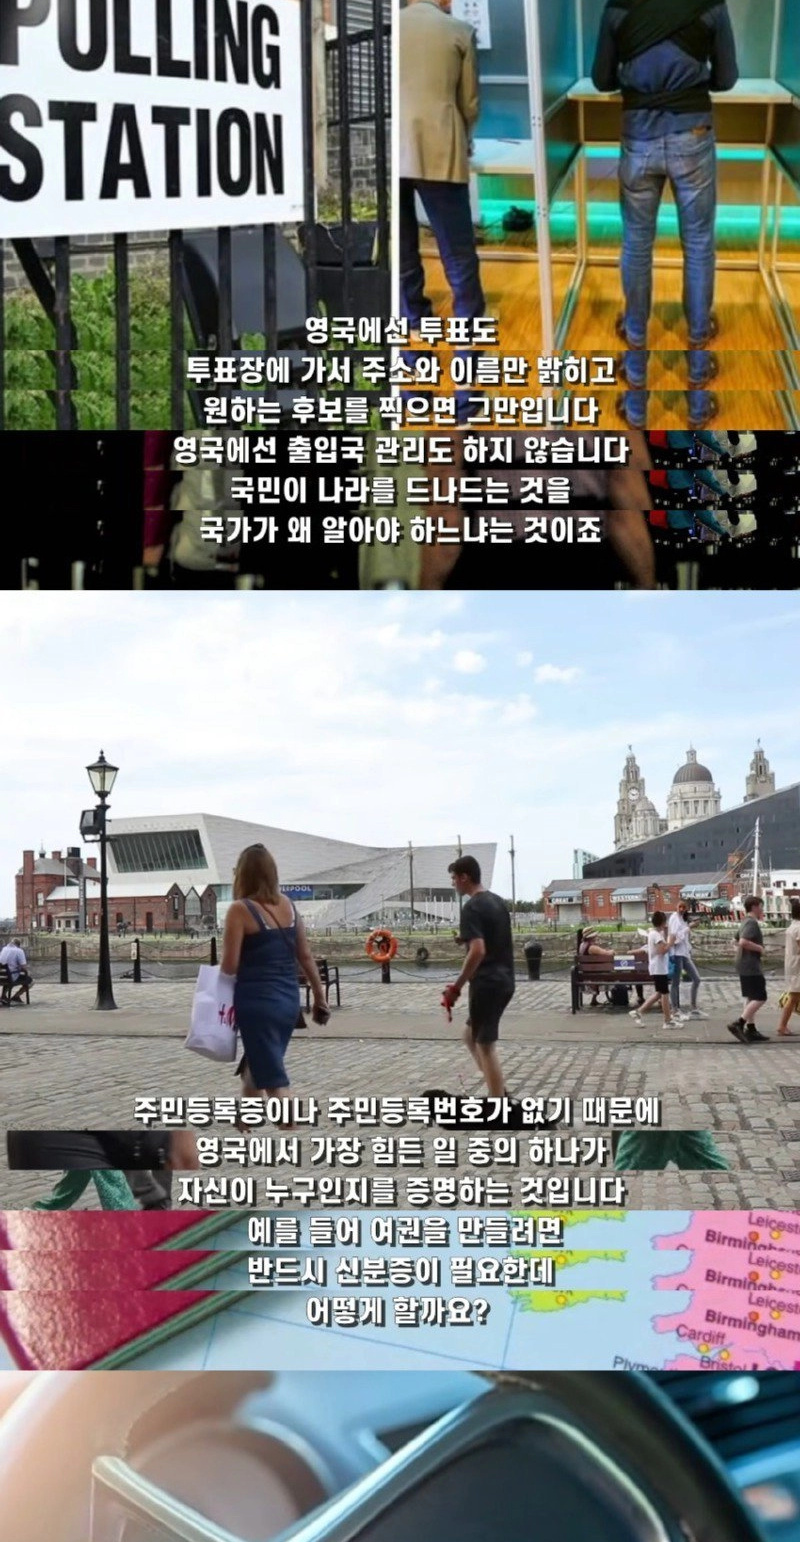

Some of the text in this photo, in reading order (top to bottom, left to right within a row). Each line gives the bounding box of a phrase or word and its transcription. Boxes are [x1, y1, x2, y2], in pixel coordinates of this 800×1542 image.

[0, 93, 285, 203] STATION
[676, 1324, 726, 1345] Cardiff
[705, 1310, 800, 1341] Birmingham
